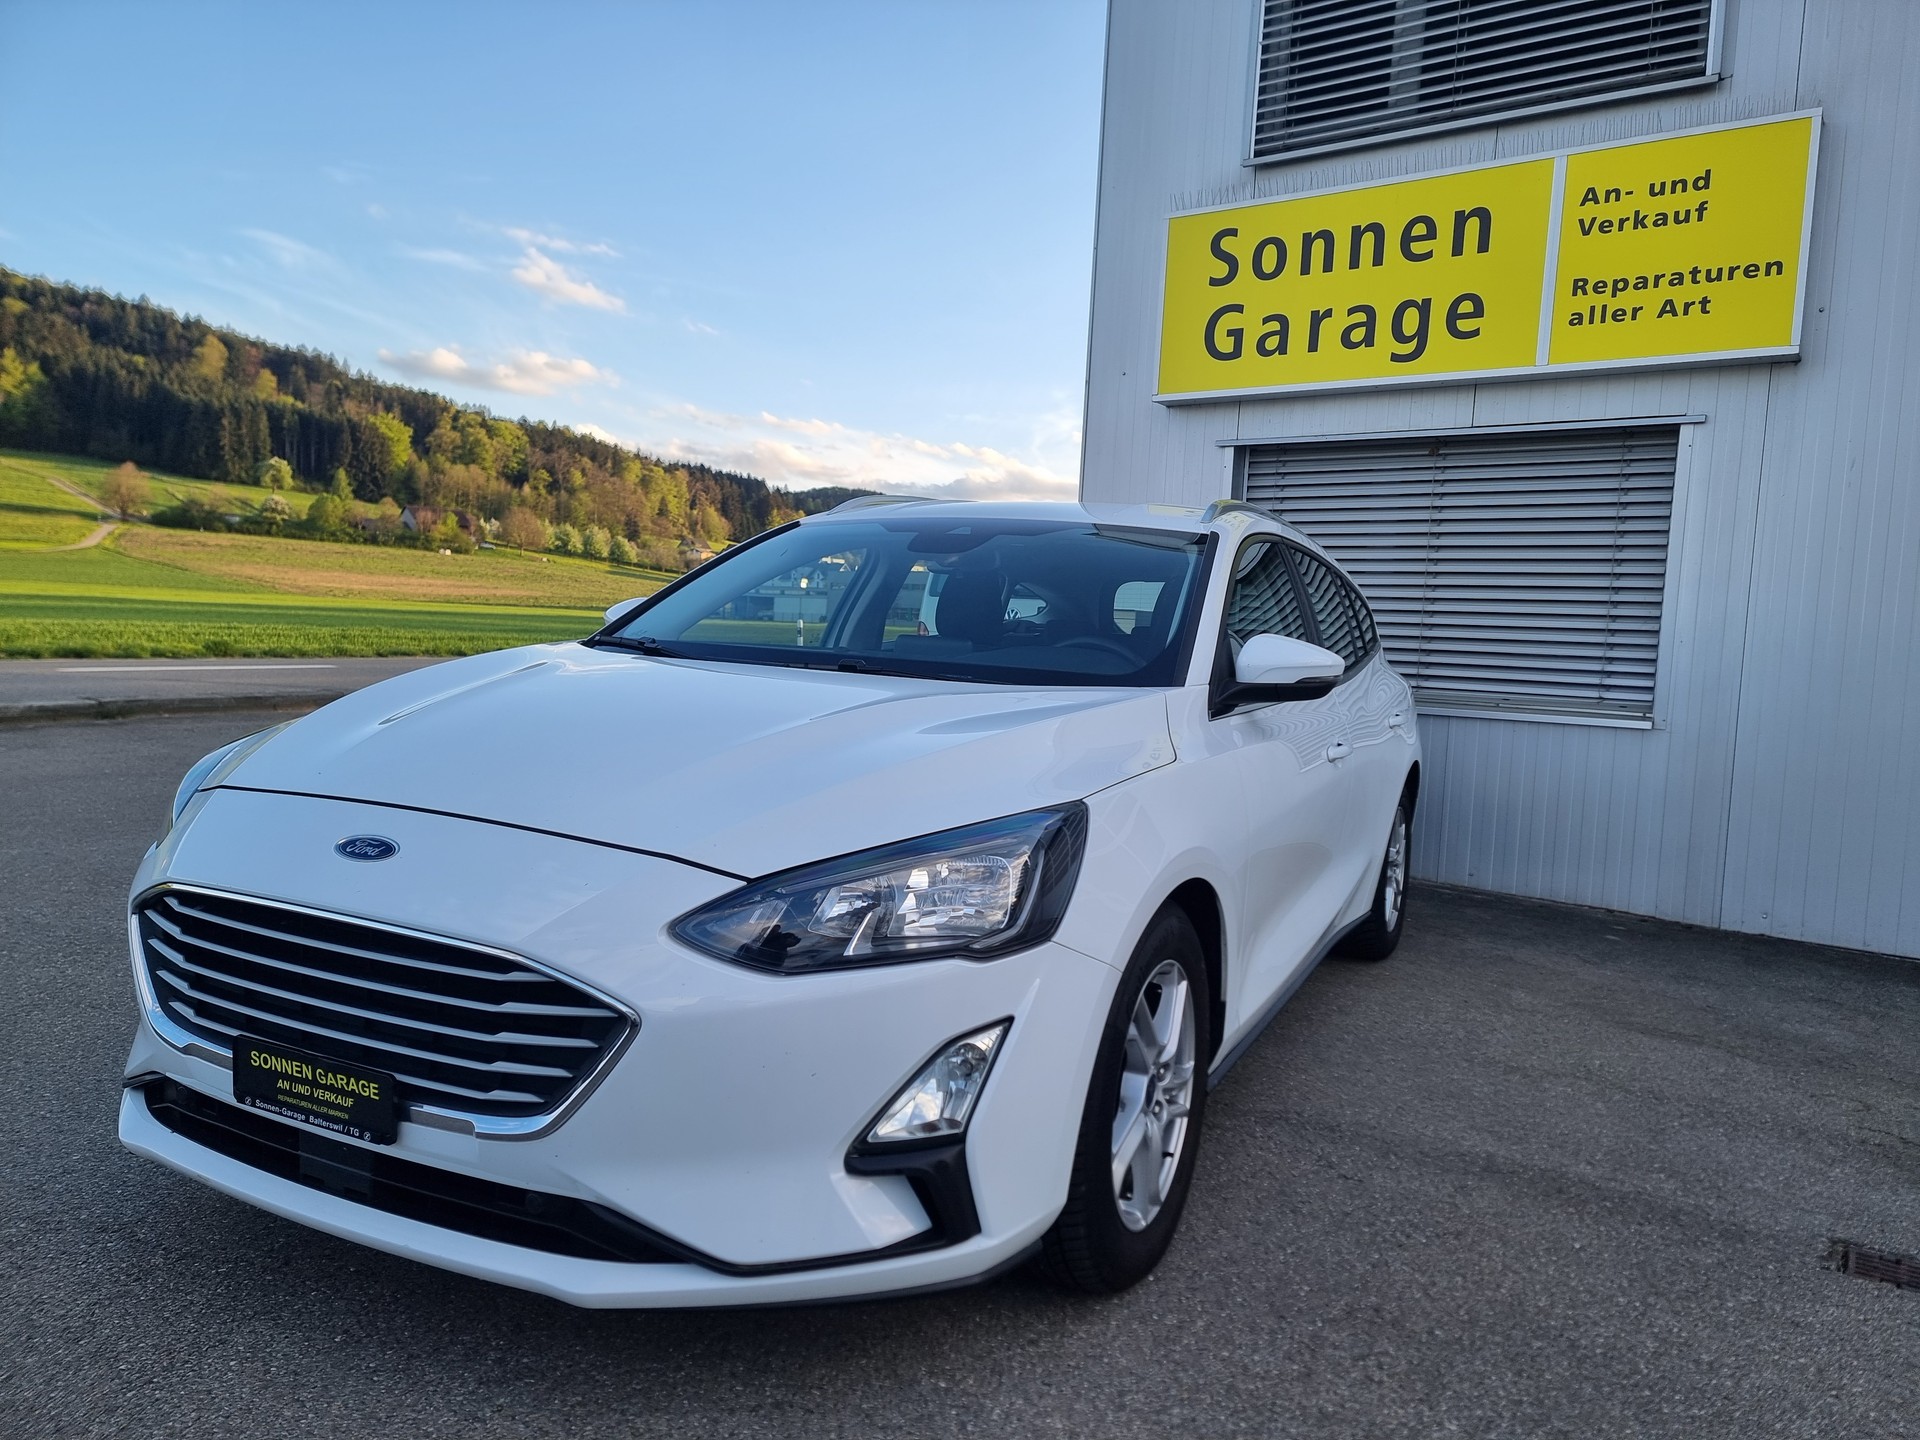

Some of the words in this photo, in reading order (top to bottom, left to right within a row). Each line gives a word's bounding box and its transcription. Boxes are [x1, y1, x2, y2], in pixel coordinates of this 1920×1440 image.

[1579, 186, 1634, 207] An-
[1649, 169, 1712, 197] und
[1578, 200, 1709, 237] Verkauf
[1208, 206, 1492, 287] Sonnen
[1571, 260, 1784, 298] Reparaturen
[1203, 292, 1485, 363] Garage
[1568, 304, 1643, 327] aller
[1656, 295, 1712, 319] Art
[346, 839, 386, 856] Ford
[250, 1050, 312, 1080] SONNEN
[316, 1069, 379, 1100] GARAGE
[277, 1079, 290, 1090] AN
[292, 1082, 311, 1096] UND
[313, 1087, 354, 1108] VERKAUF
[255, 1099, 306, 1121] Sonnen-Garage
[309, 1115, 343, 1132] Balterswil
[349, 1127, 360, 1137] TG
[278, 1094, 312, 1109] REPARATUREN
[312, 1104, 328, 1113] ALLER
[328, 1108, 349, 1119] MARKEN
